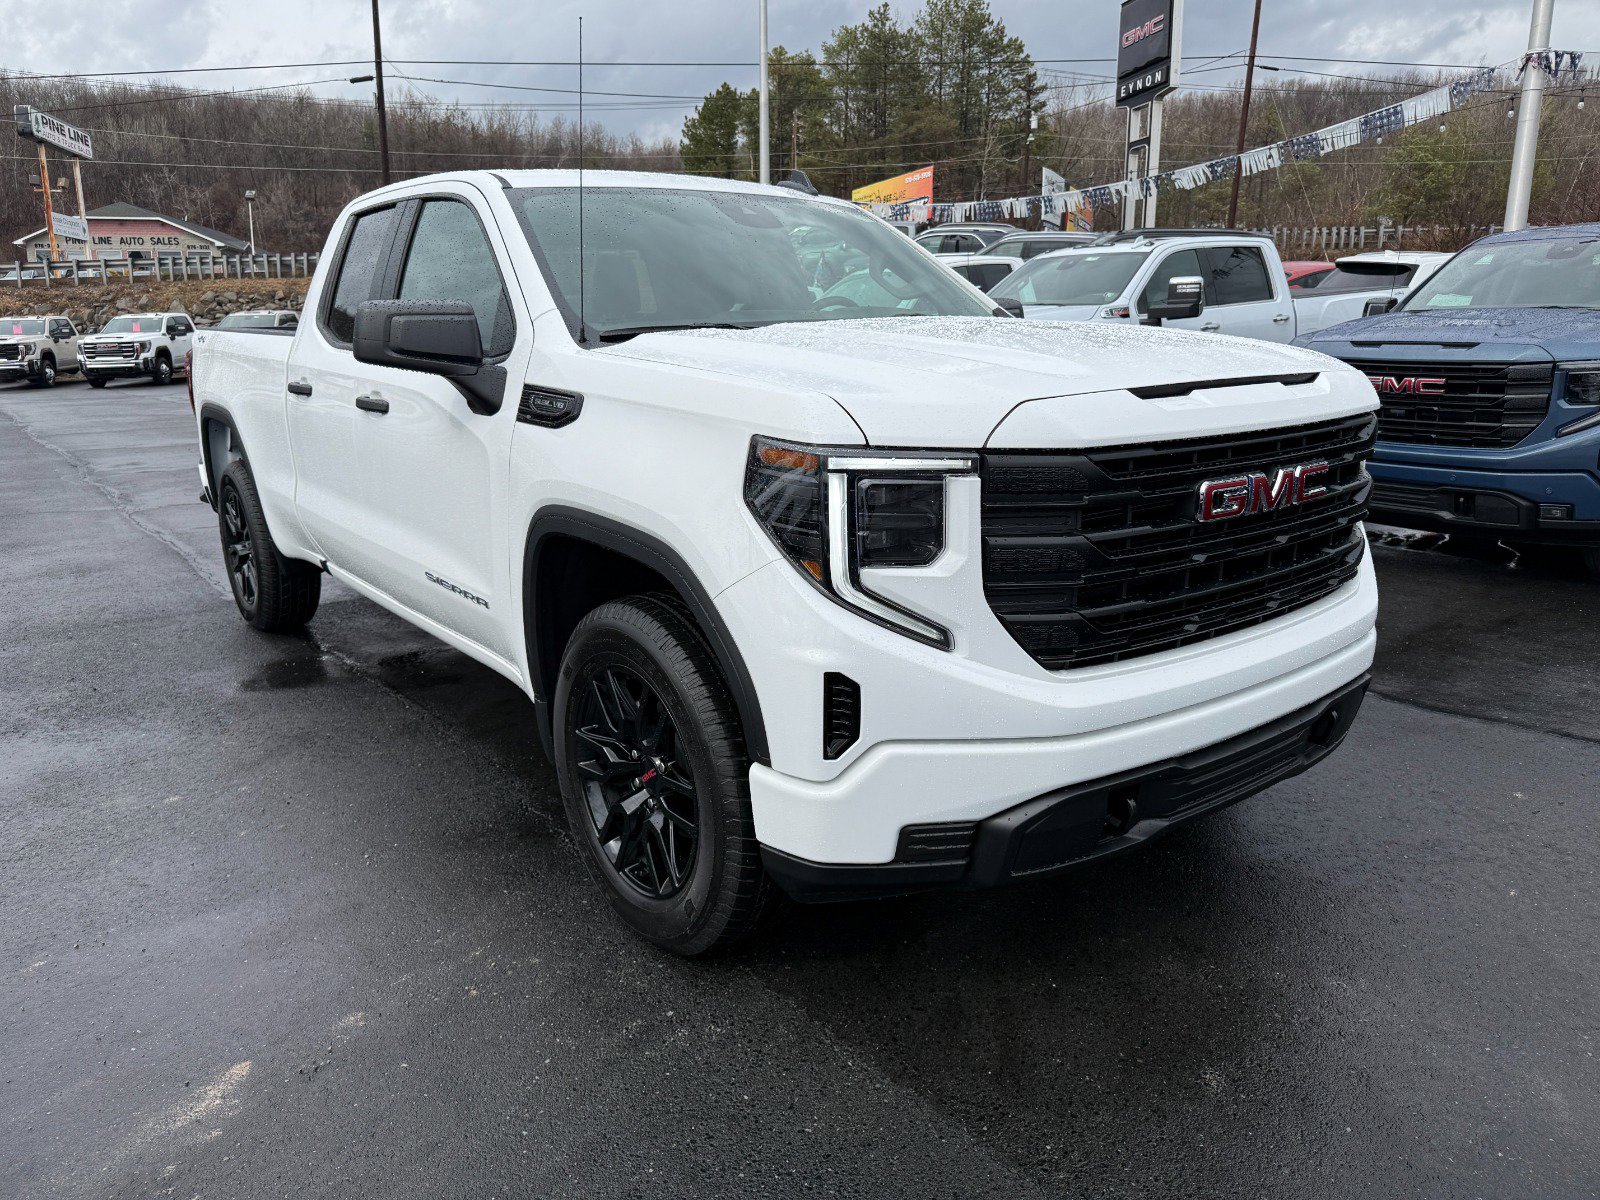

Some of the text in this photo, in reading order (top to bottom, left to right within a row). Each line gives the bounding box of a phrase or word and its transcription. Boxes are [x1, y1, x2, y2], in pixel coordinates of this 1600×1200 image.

[1122, 14, 1164, 48] GMC
[1120, 70, 1162, 97] EYNON
[41, 115, 90, 147] PINE LINE
[92, 236, 113, 245] LINE
[119, 236, 145, 246] AUTO
[150, 236, 180, 246] SALES
[1197, 459, 1330, 523] GMC
[424, 571, 490, 610] SIERRA
[640, 768, 658, 784] GMC
